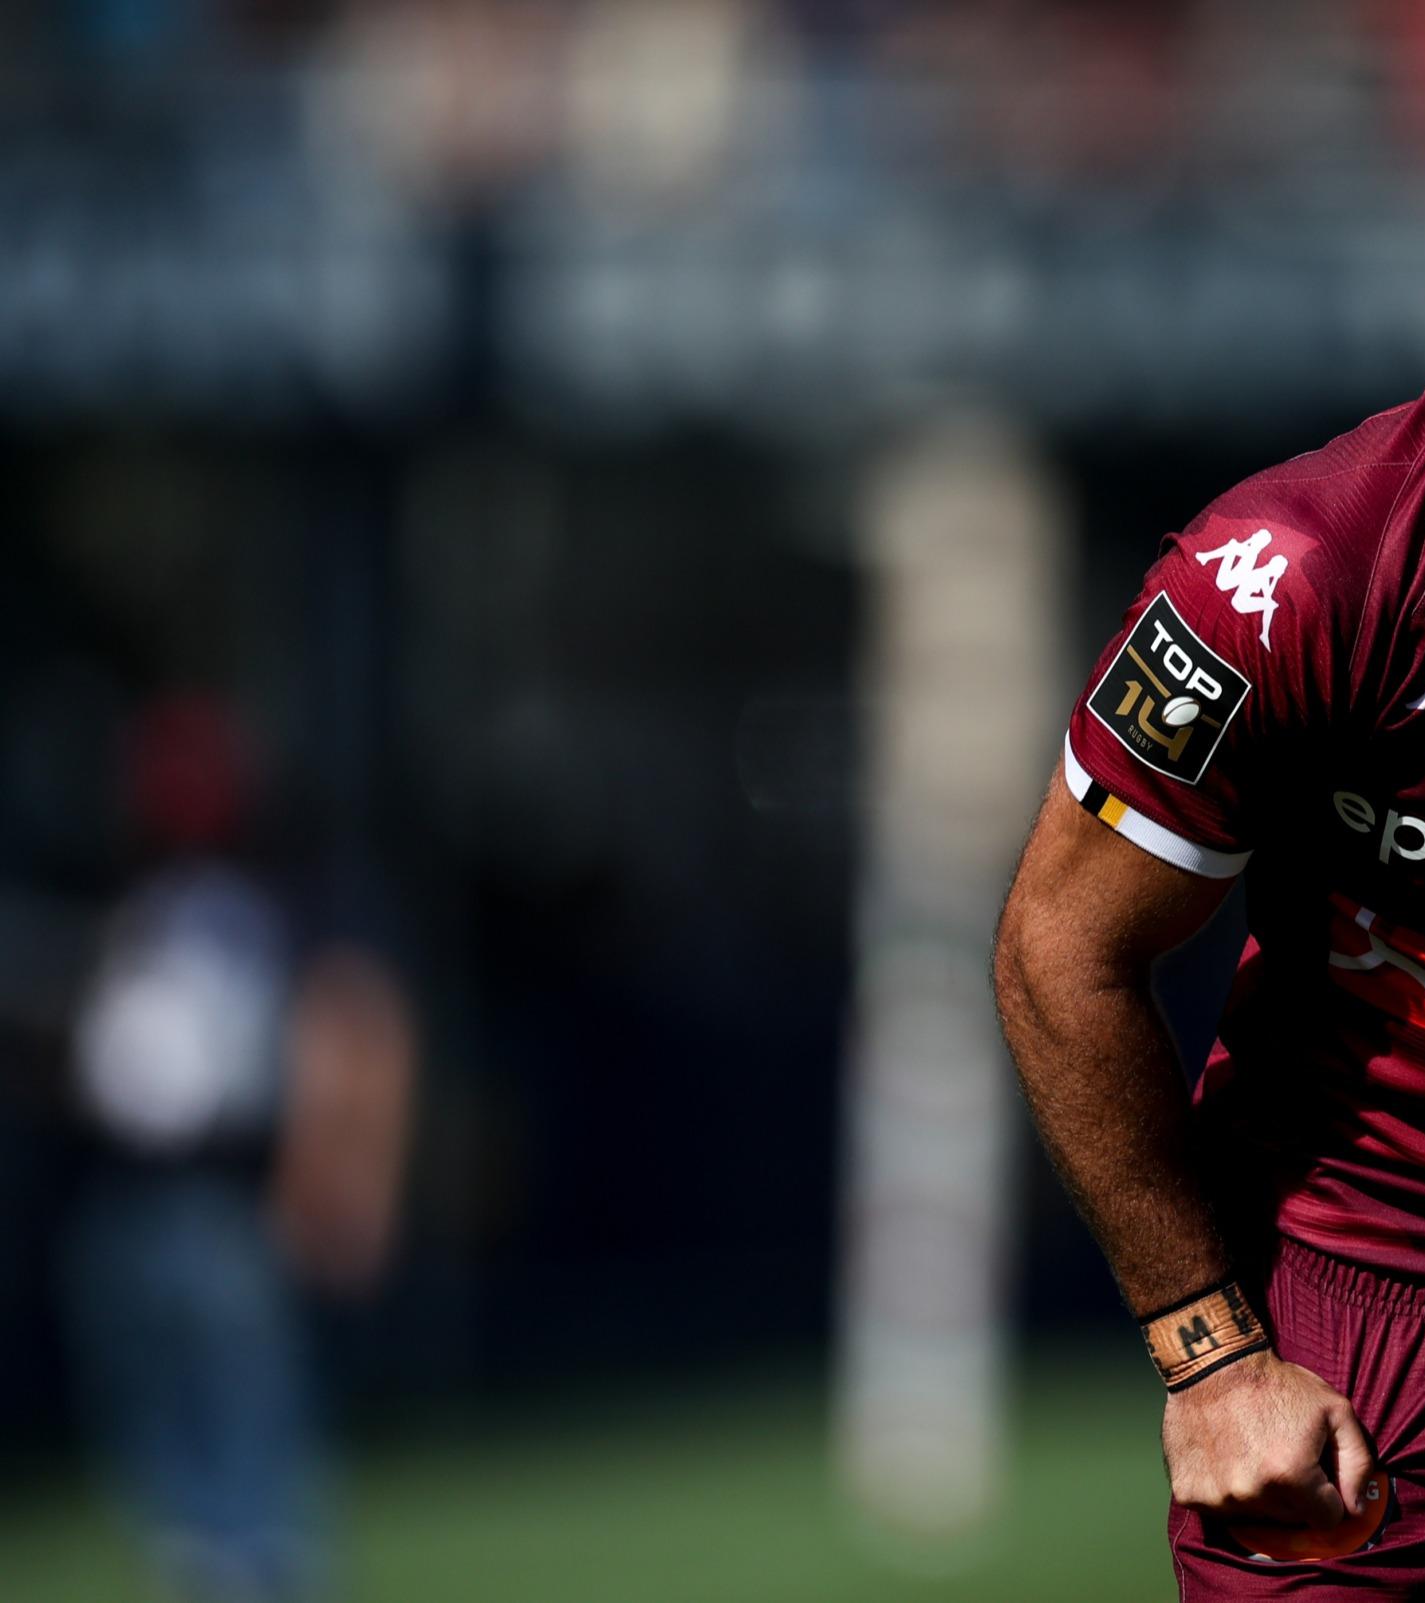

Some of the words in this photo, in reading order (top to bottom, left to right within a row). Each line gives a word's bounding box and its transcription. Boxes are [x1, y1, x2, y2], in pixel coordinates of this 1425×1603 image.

[1149, 618, 1224, 702] TOP
[1114, 680, 1195, 763] 14
[1127, 723, 1154, 753] RUGBY
[1178, 1314, 1220, 1359] M
